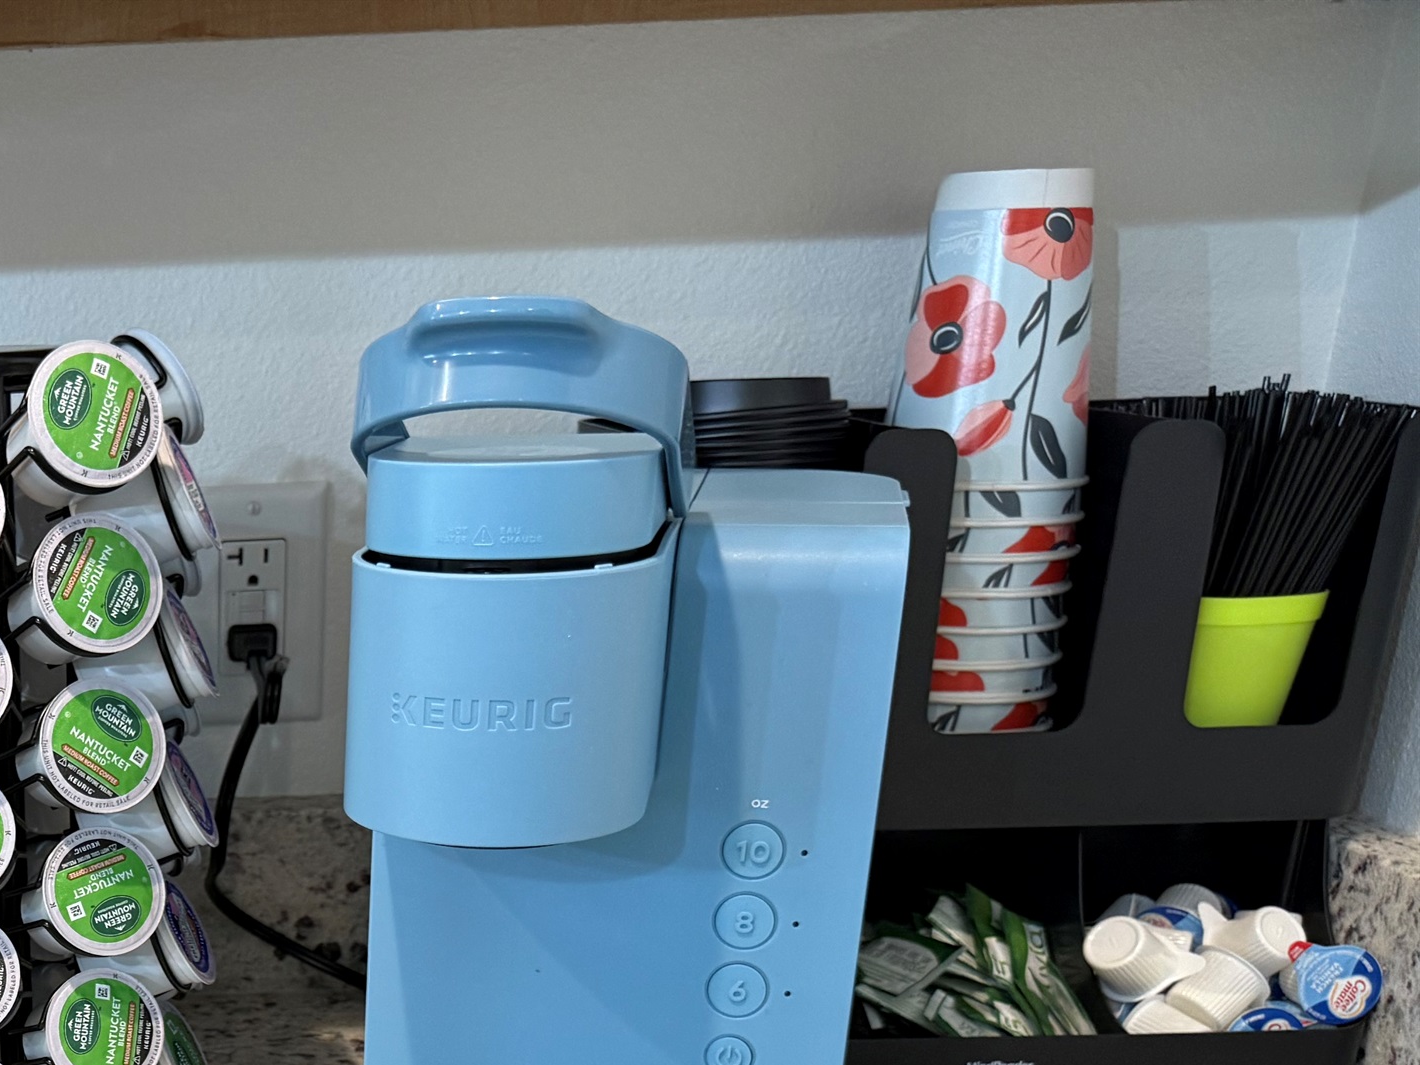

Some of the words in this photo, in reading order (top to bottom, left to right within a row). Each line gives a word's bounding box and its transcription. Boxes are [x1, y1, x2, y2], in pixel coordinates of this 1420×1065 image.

[56, 379, 73, 414] GREEN
[62, 375, 83, 425] MOUNTAIN
[89, 376, 120, 450] NANTUCKET
[106, 404, 120, 434] BLEND
[134, 417, 149, 447] KEURIG
[49, 543, 66, 571] KEURIG
[78, 557, 95, 584] BLEND
[75, 544, 113, 612] NANTUCKET
[109, 572, 135, 618] MOUNTAIN
[120, 583, 139, 615] GREEN
[94, 705, 136, 737] MOUNTAIN
[103, 702, 133, 725] GREEN
[390, 691, 572, 732] KEURIG
[68, 725, 131, 772] NANTUCKET
[82, 746, 107, 766] BLEND
[67, 774, 94, 795] KEURIG
[751, 799, 770, 810] OZ
[74, 840, 100, 854] KEURIG
[736, 839, 772, 865] 10
[71, 868, 134, 899] NANTUCKET
[89, 867, 113, 881] BLEND
[93, 902, 135, 924] MOUNTAIN
[103, 911, 132, 928] GREEN
[734, 910, 755, 935] 8
[728, 980, 748, 1003] 6
[1333, 981, 1353, 1009] mate
[1340, 979, 1367, 1012] Coffee
[73, 1010, 82, 1041] GREEN
[79, 1003, 91, 1049] MOUNTAIN
[105, 996, 121, 1064] NANTUCKET
[117, 1020, 126, 1046] BLEND
[143, 1021, 151, 1049] KEURIG
